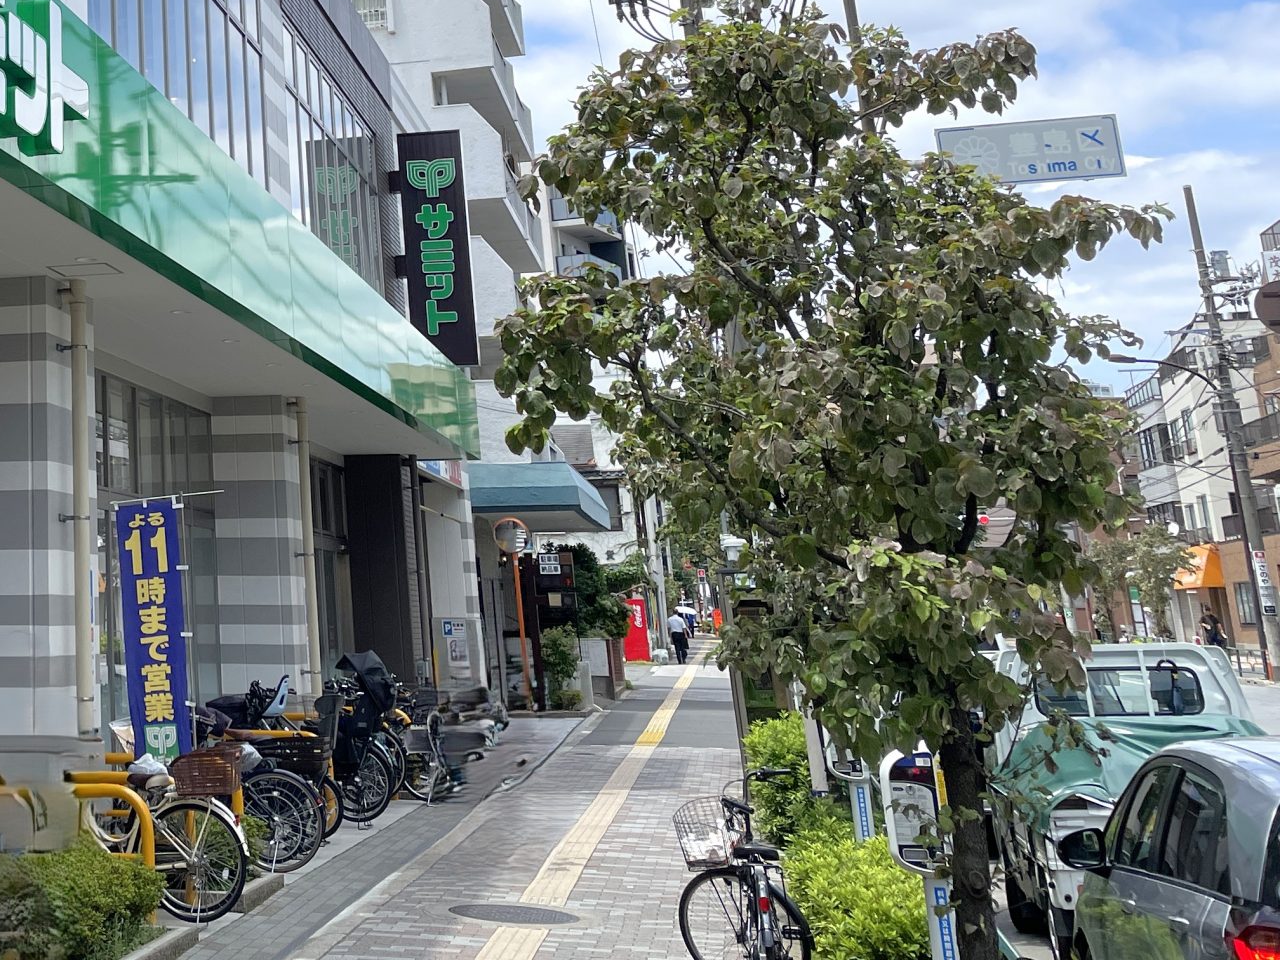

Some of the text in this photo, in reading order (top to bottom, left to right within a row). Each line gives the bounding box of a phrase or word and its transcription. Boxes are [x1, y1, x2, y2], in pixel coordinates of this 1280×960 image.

[415, 203, 458, 335] サミット
[124, 527, 169, 575] 11
[128, 512, 165, 528] よる
[135, 577, 175, 722] 時まで営業
